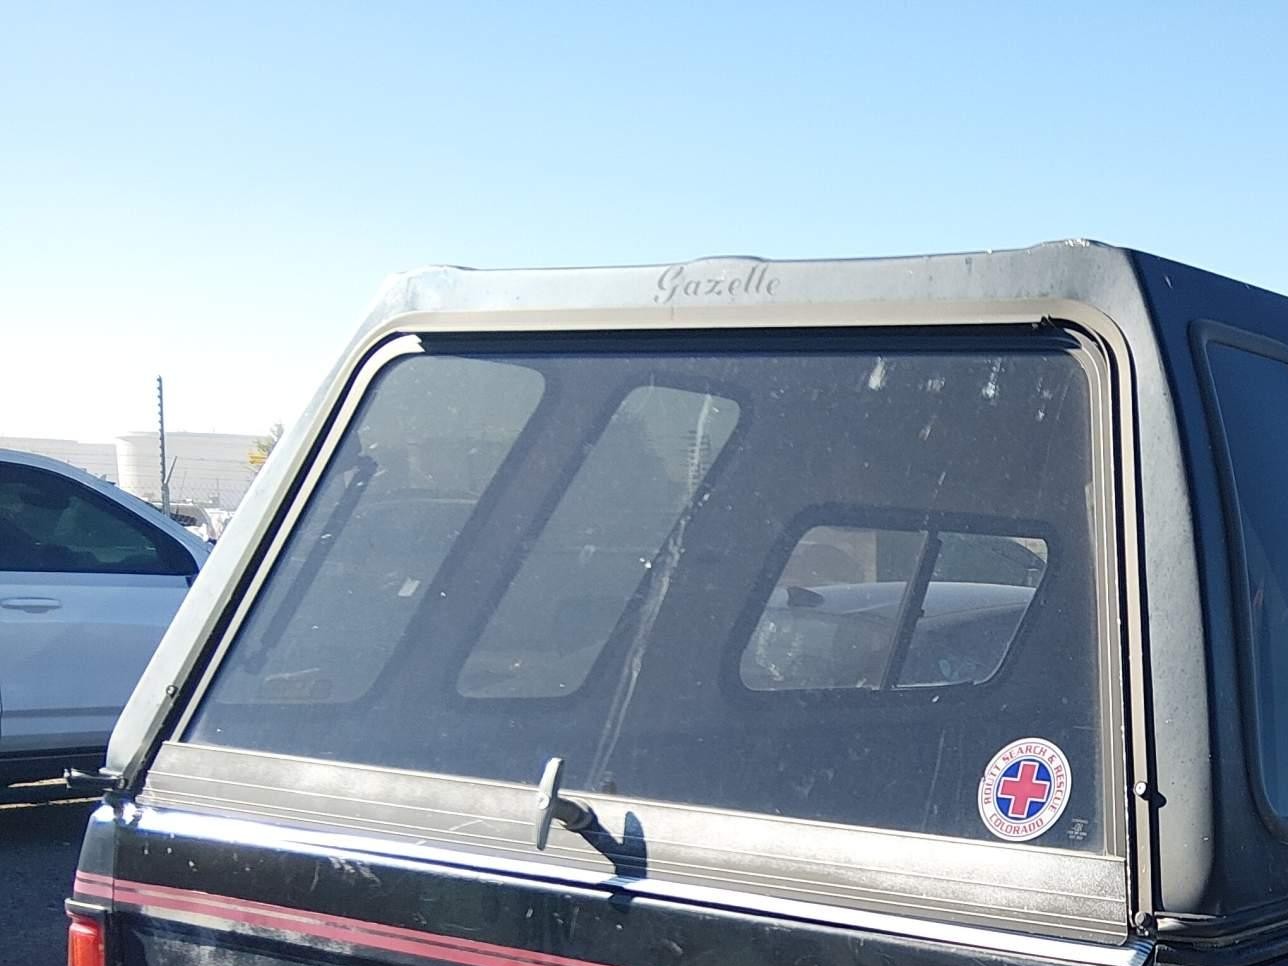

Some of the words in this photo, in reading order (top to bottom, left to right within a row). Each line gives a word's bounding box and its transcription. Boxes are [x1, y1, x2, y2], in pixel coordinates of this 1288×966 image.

[653, 265, 781, 304] Gazelle
[1002, 745, 1048, 762] SEARCH
[1047, 754, 1057, 764] &
[1047, 764, 1065, 813] RESCUE
[989, 812, 1044, 835] COLORADO
